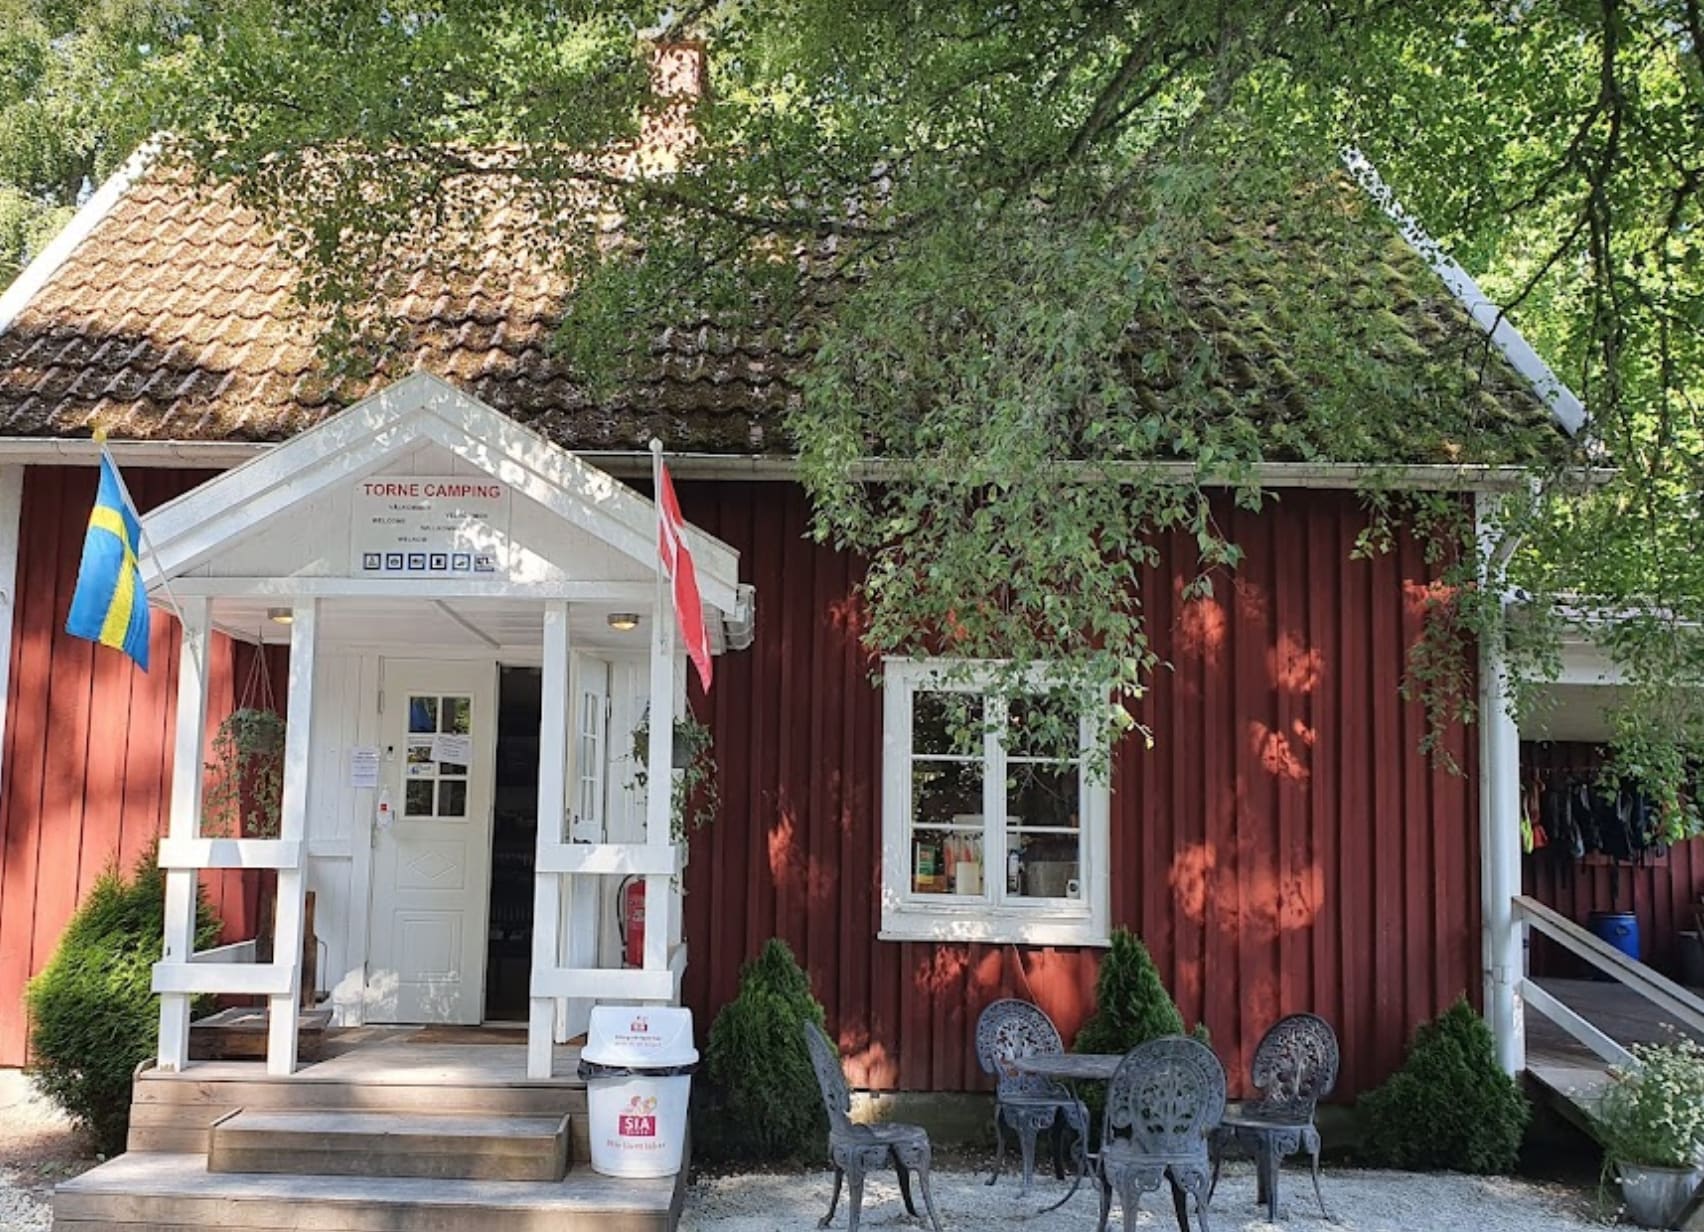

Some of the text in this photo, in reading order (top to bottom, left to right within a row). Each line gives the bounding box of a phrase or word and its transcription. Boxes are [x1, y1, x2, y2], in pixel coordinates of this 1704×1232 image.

[364, 483, 501, 498] TORNE CAMPING
[624, 1117, 651, 1129] SIA
